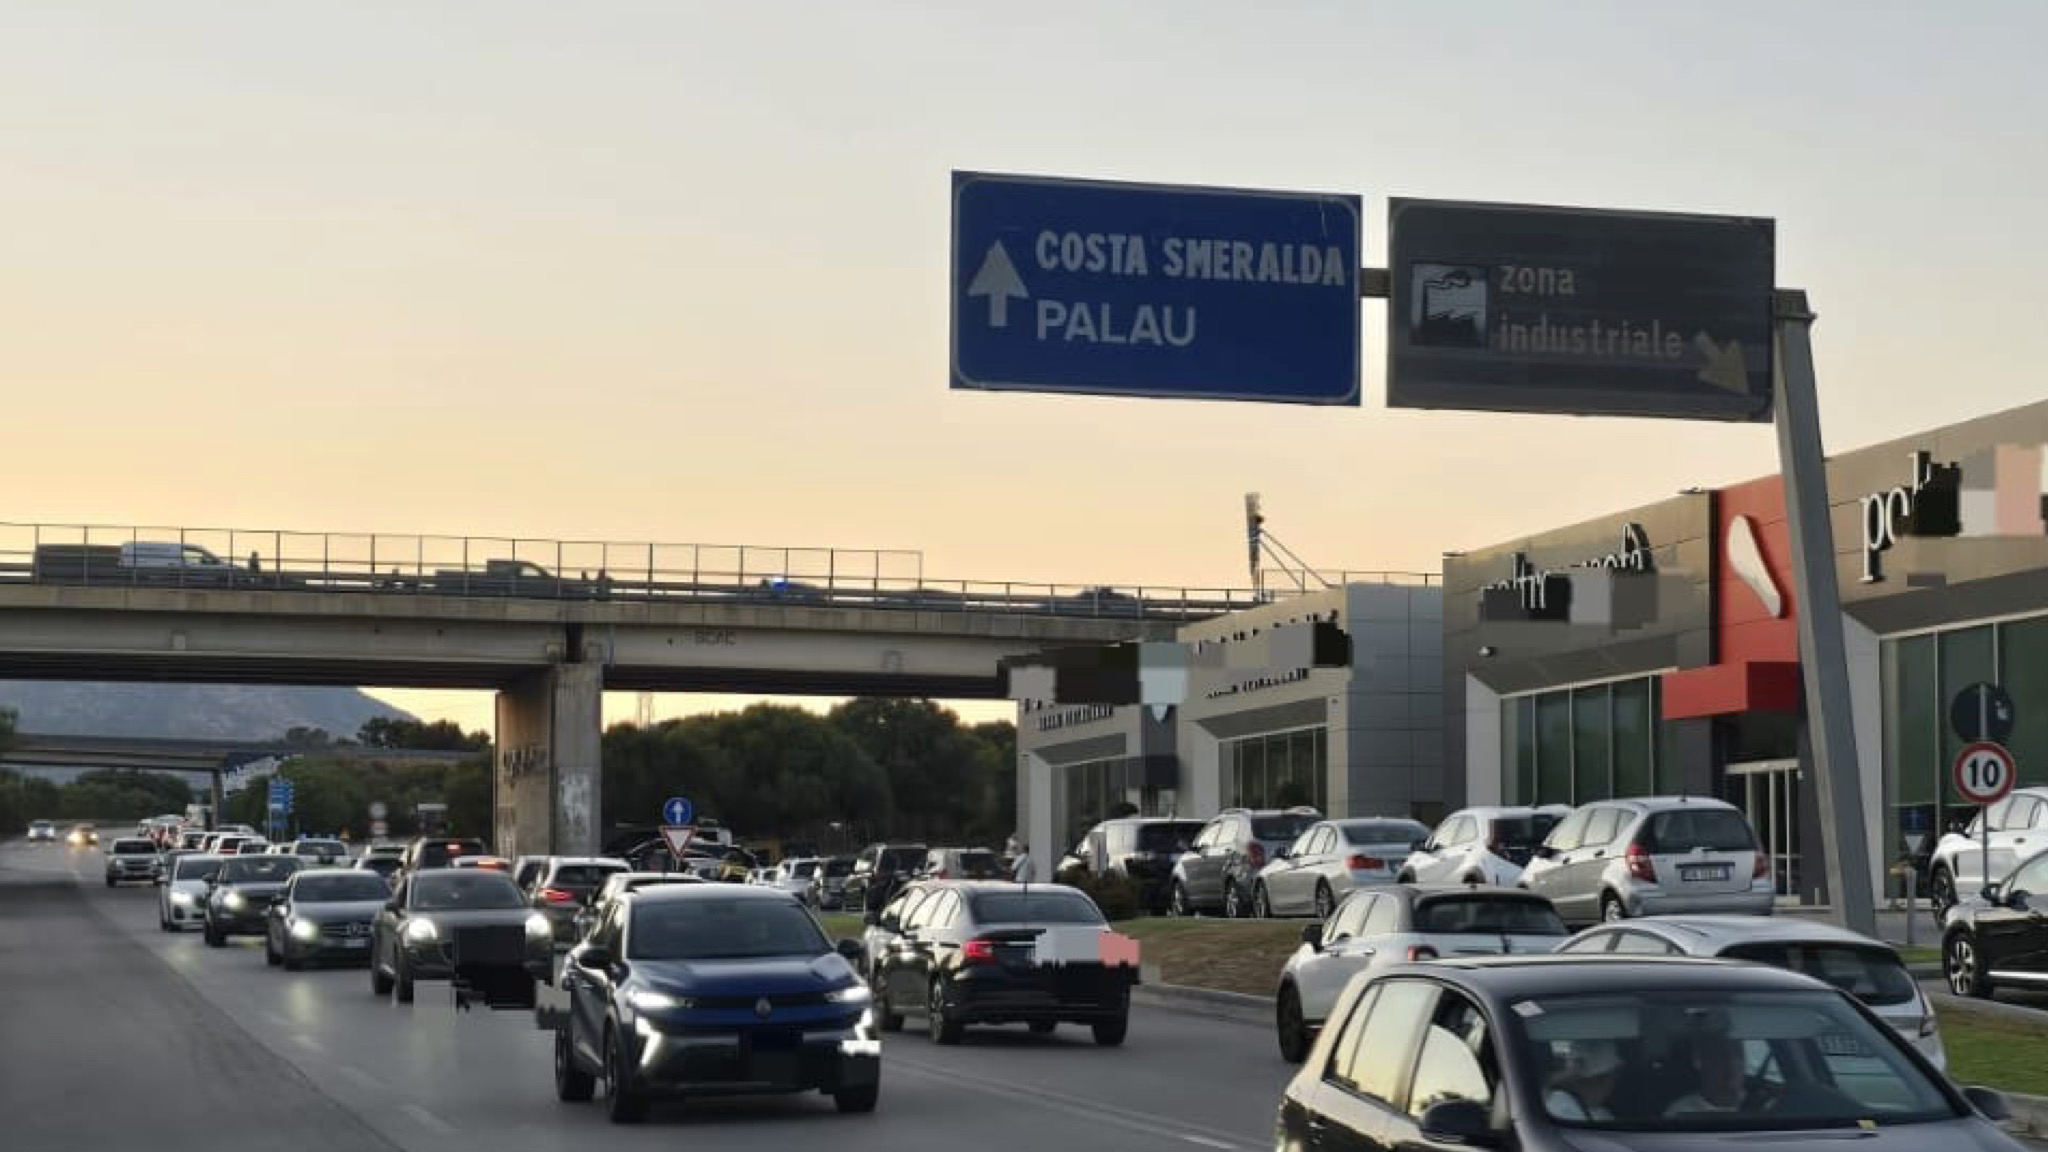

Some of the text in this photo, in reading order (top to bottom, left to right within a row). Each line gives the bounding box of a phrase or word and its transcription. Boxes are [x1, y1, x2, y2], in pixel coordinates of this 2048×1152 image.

[1035, 231, 1345, 286] COSTA SMERALDA
[1500, 266, 1574, 295] zona
[1037, 300, 1197, 345] PALAU
[1501, 313, 1682, 357] industriale
[1968, 758, 1999, 788] 10
